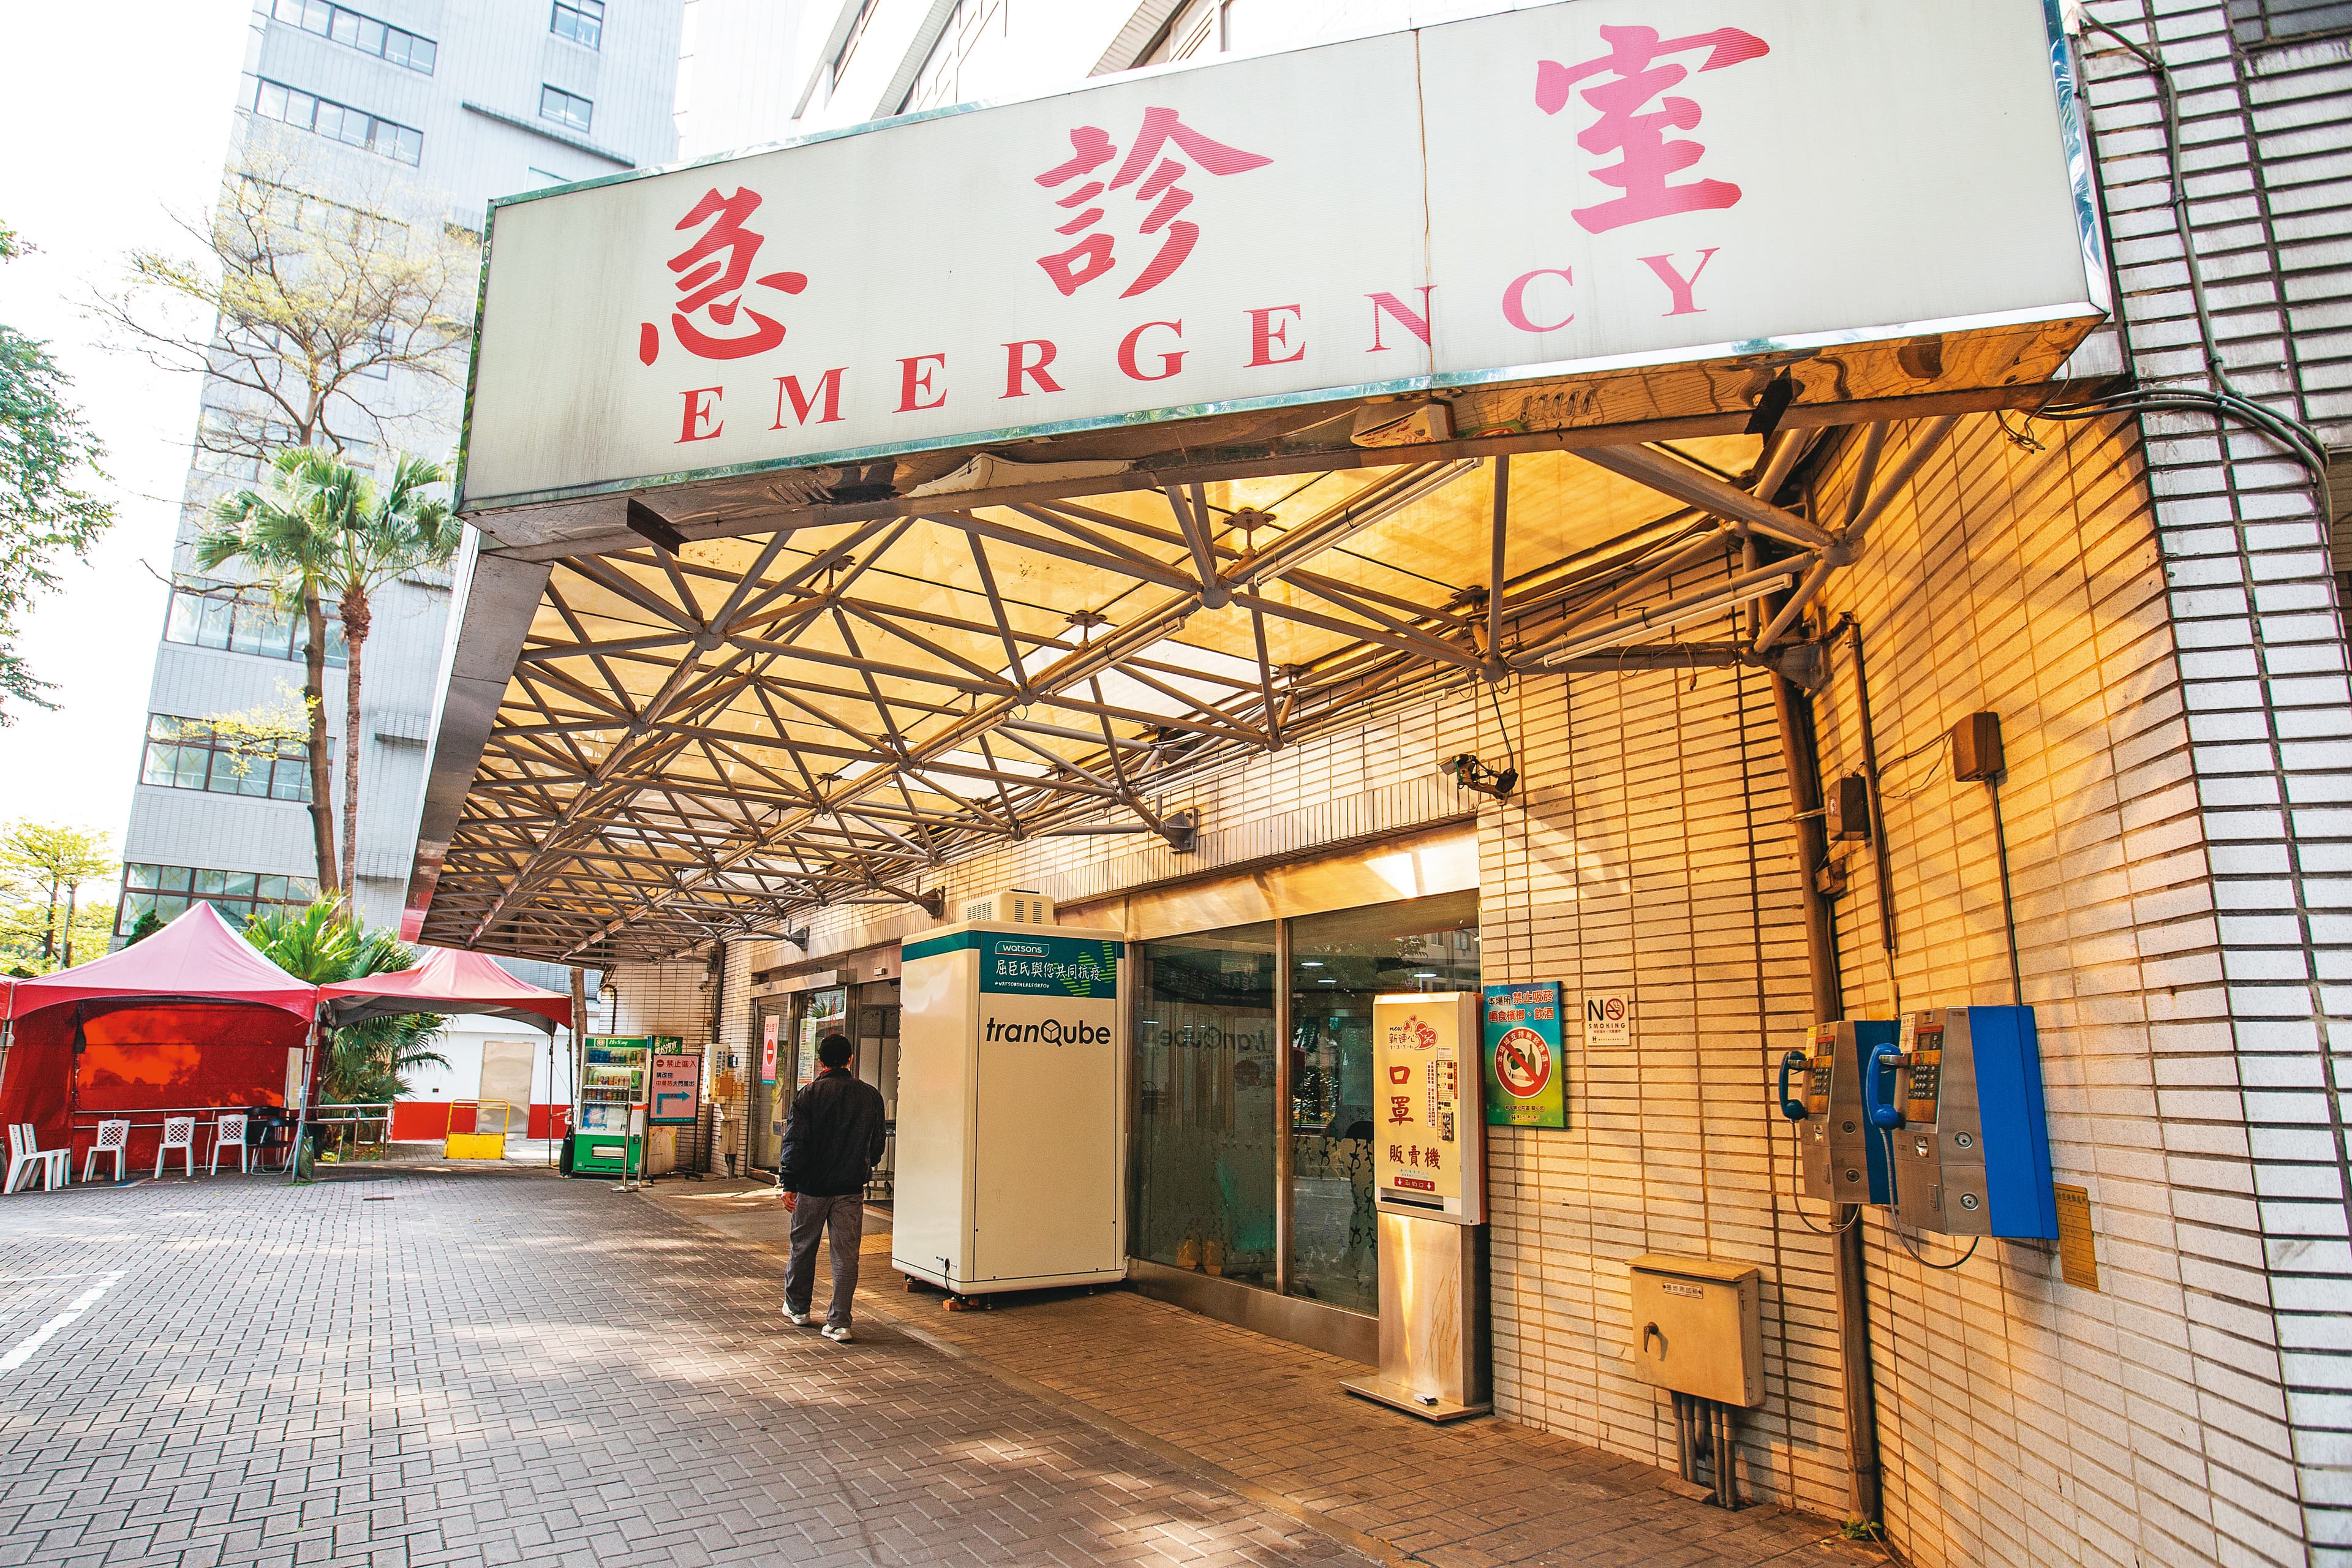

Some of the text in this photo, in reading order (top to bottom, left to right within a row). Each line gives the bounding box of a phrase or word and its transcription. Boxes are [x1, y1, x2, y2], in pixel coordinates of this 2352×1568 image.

[639, 24, 1771, 366] 急診室
[674, 247, 1721, 444] EMERGENCY
[1003, 944, 1042, 954] watsons
[995, 959, 1102, 981] 屈臣氏與您共同抗疫
[1488, 989, 1554, 1006] 本場所 禁止吸菸
[986, 1017, 1111, 1047] tranQube
[1388, 1065, 1414, 1127] 口罩
[1389, 1144, 1441, 1170] 販賣機
